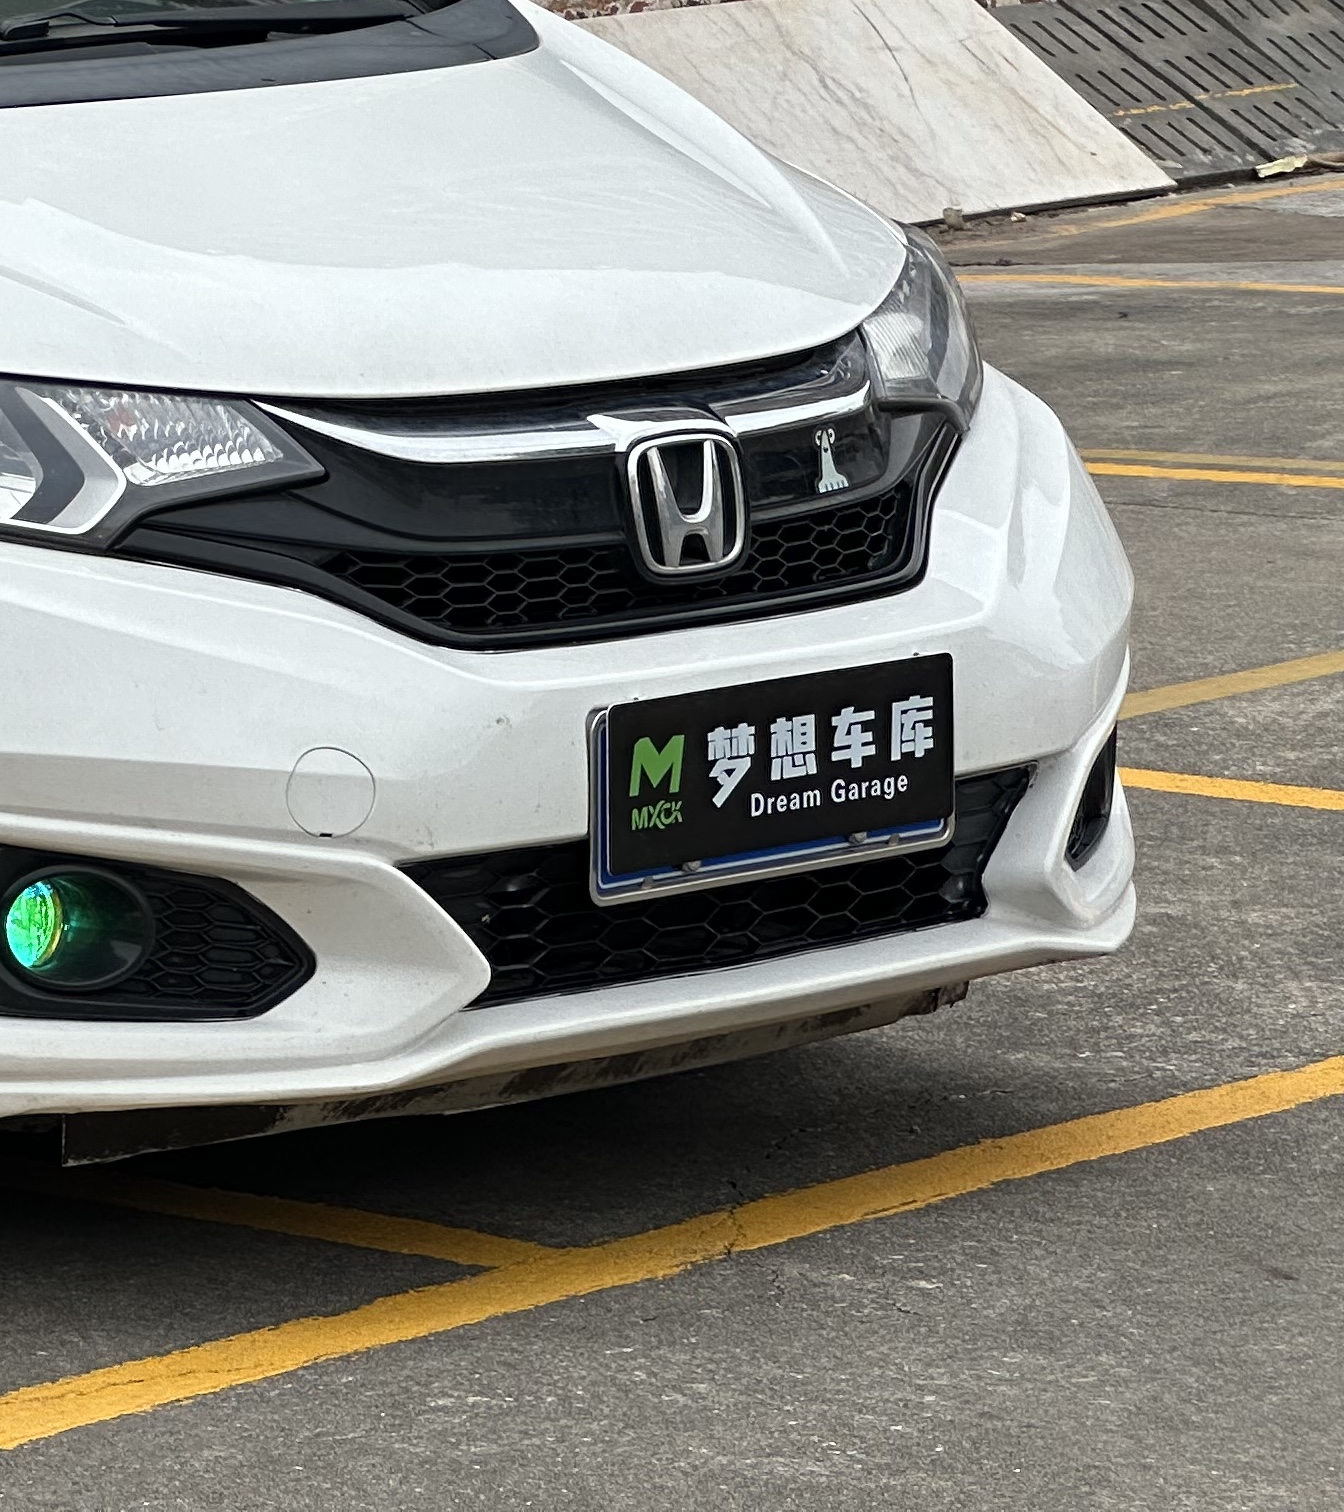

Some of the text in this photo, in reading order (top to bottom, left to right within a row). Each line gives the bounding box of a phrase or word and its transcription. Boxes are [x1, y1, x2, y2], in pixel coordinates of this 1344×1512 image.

[707, 694, 935, 809] 梦想车库
[750, 773, 909, 818] Dream Garage
